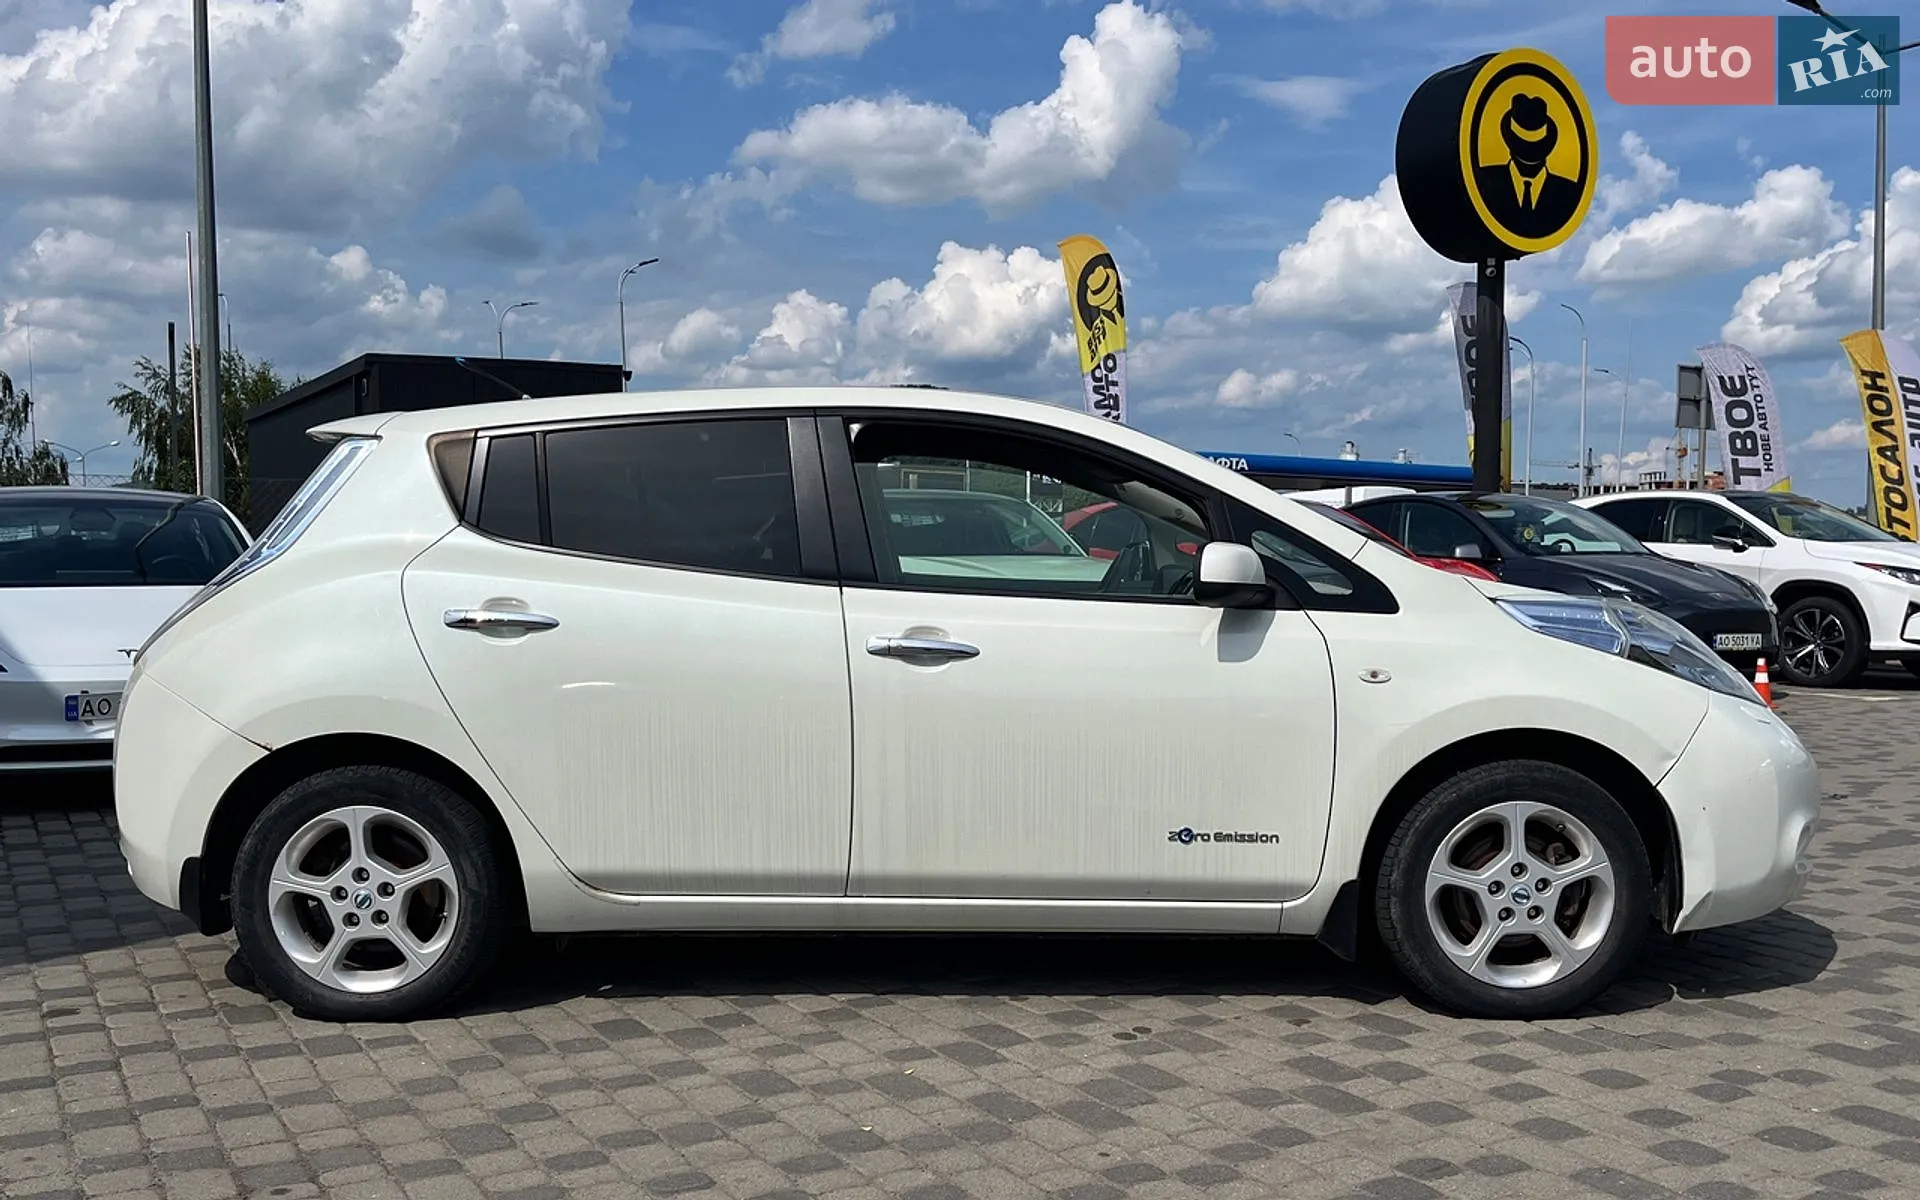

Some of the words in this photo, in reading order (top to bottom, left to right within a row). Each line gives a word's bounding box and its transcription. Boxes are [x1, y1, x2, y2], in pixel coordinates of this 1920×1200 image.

[1745, 364, 1760, 391] ТУТ
[1718, 374, 1761, 485] ТВОЄ
[1753, 394, 1769, 431] АВТО
[1760, 433, 1773, 472] НОВЕ
[1213, 831, 1280, 844] Emission
